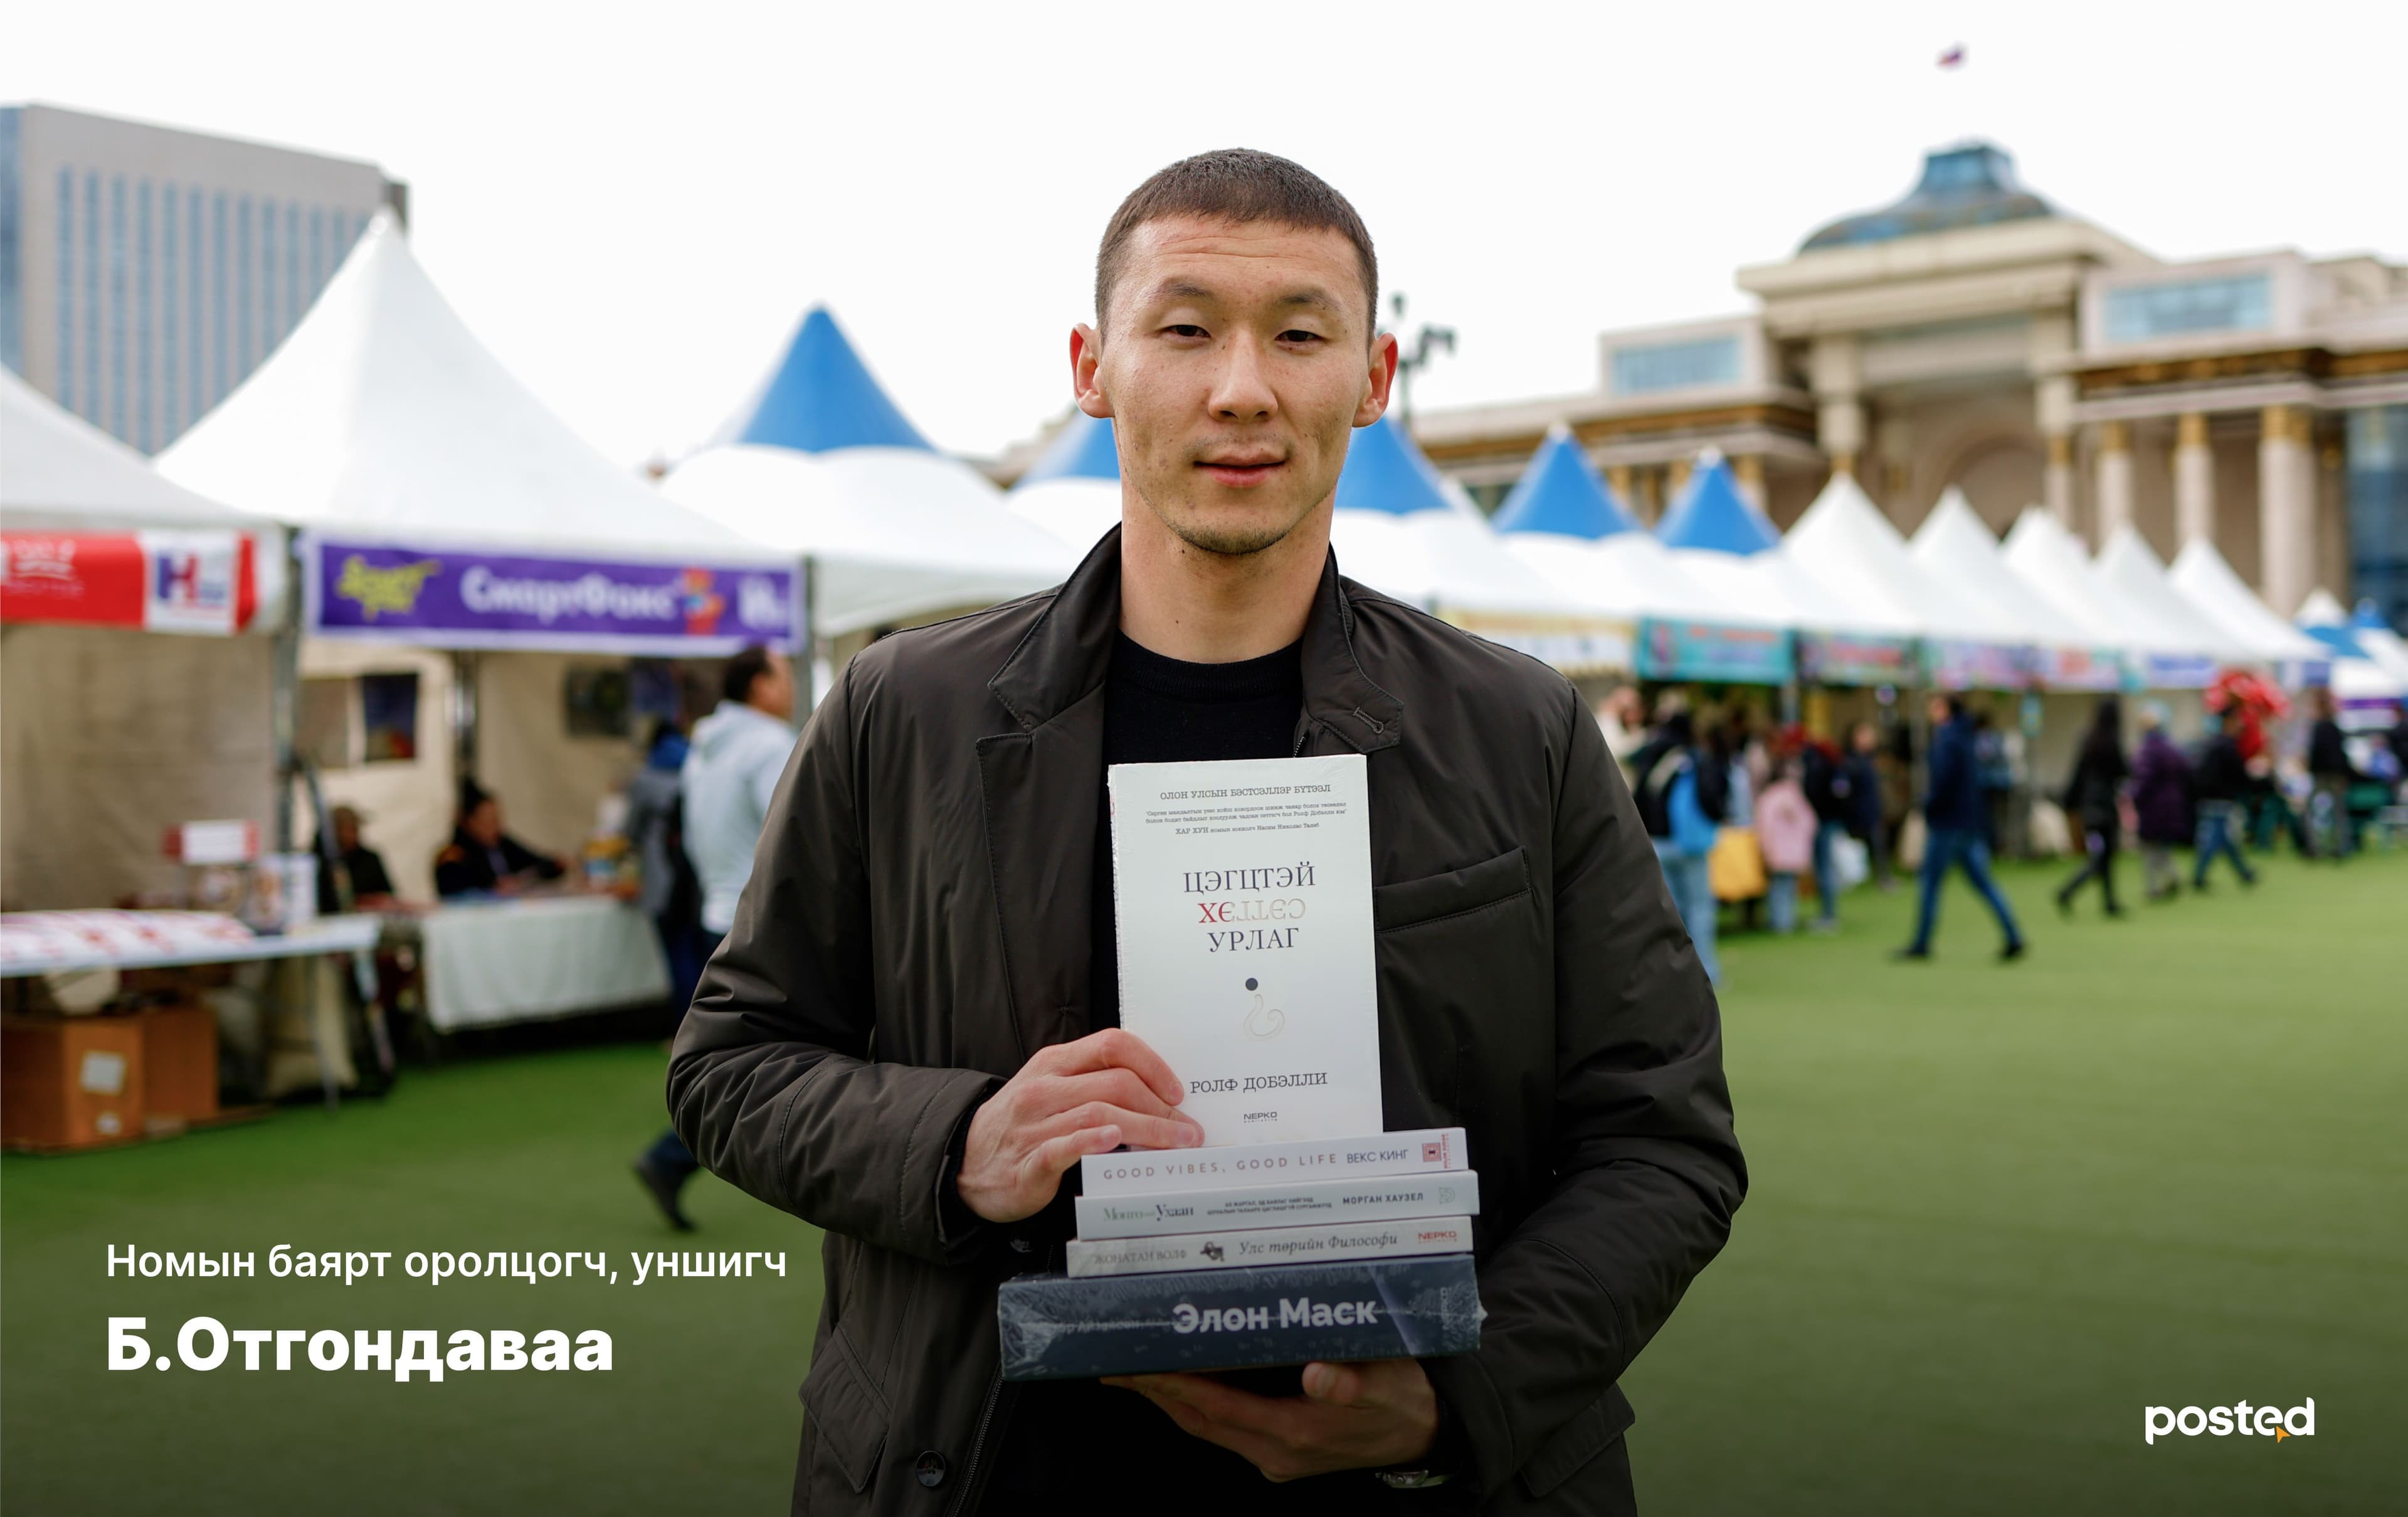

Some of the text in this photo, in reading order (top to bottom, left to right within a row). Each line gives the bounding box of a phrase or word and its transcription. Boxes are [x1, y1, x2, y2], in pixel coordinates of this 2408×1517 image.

[1160, 791, 1188, 800] ОЛОН
[1191, 790, 1227, 798] УЛСЫН
[1294, 784, 1331, 793] БҮТЭЭЛ
[1183, 861, 1316, 896] ЦЭГЦТЭЙ
[1207, 928, 1299, 953] УРЛАГ
[1190, 1073, 1328, 1094] РОЛФ ДОБЭЛЛИ
[1104, 1154, 1336, 1180] GOOD VIBES, GOOD LIFE
[1347, 1150, 1409, 1164] ВЕКС КИНГ
[1343, 1193, 1423, 1205] МОРГАН ХАУЗЕЛ
[1239, 1231, 1398, 1255] Улс төрийн Философи
[1172, 1296, 1377, 1335] Элон Маск
